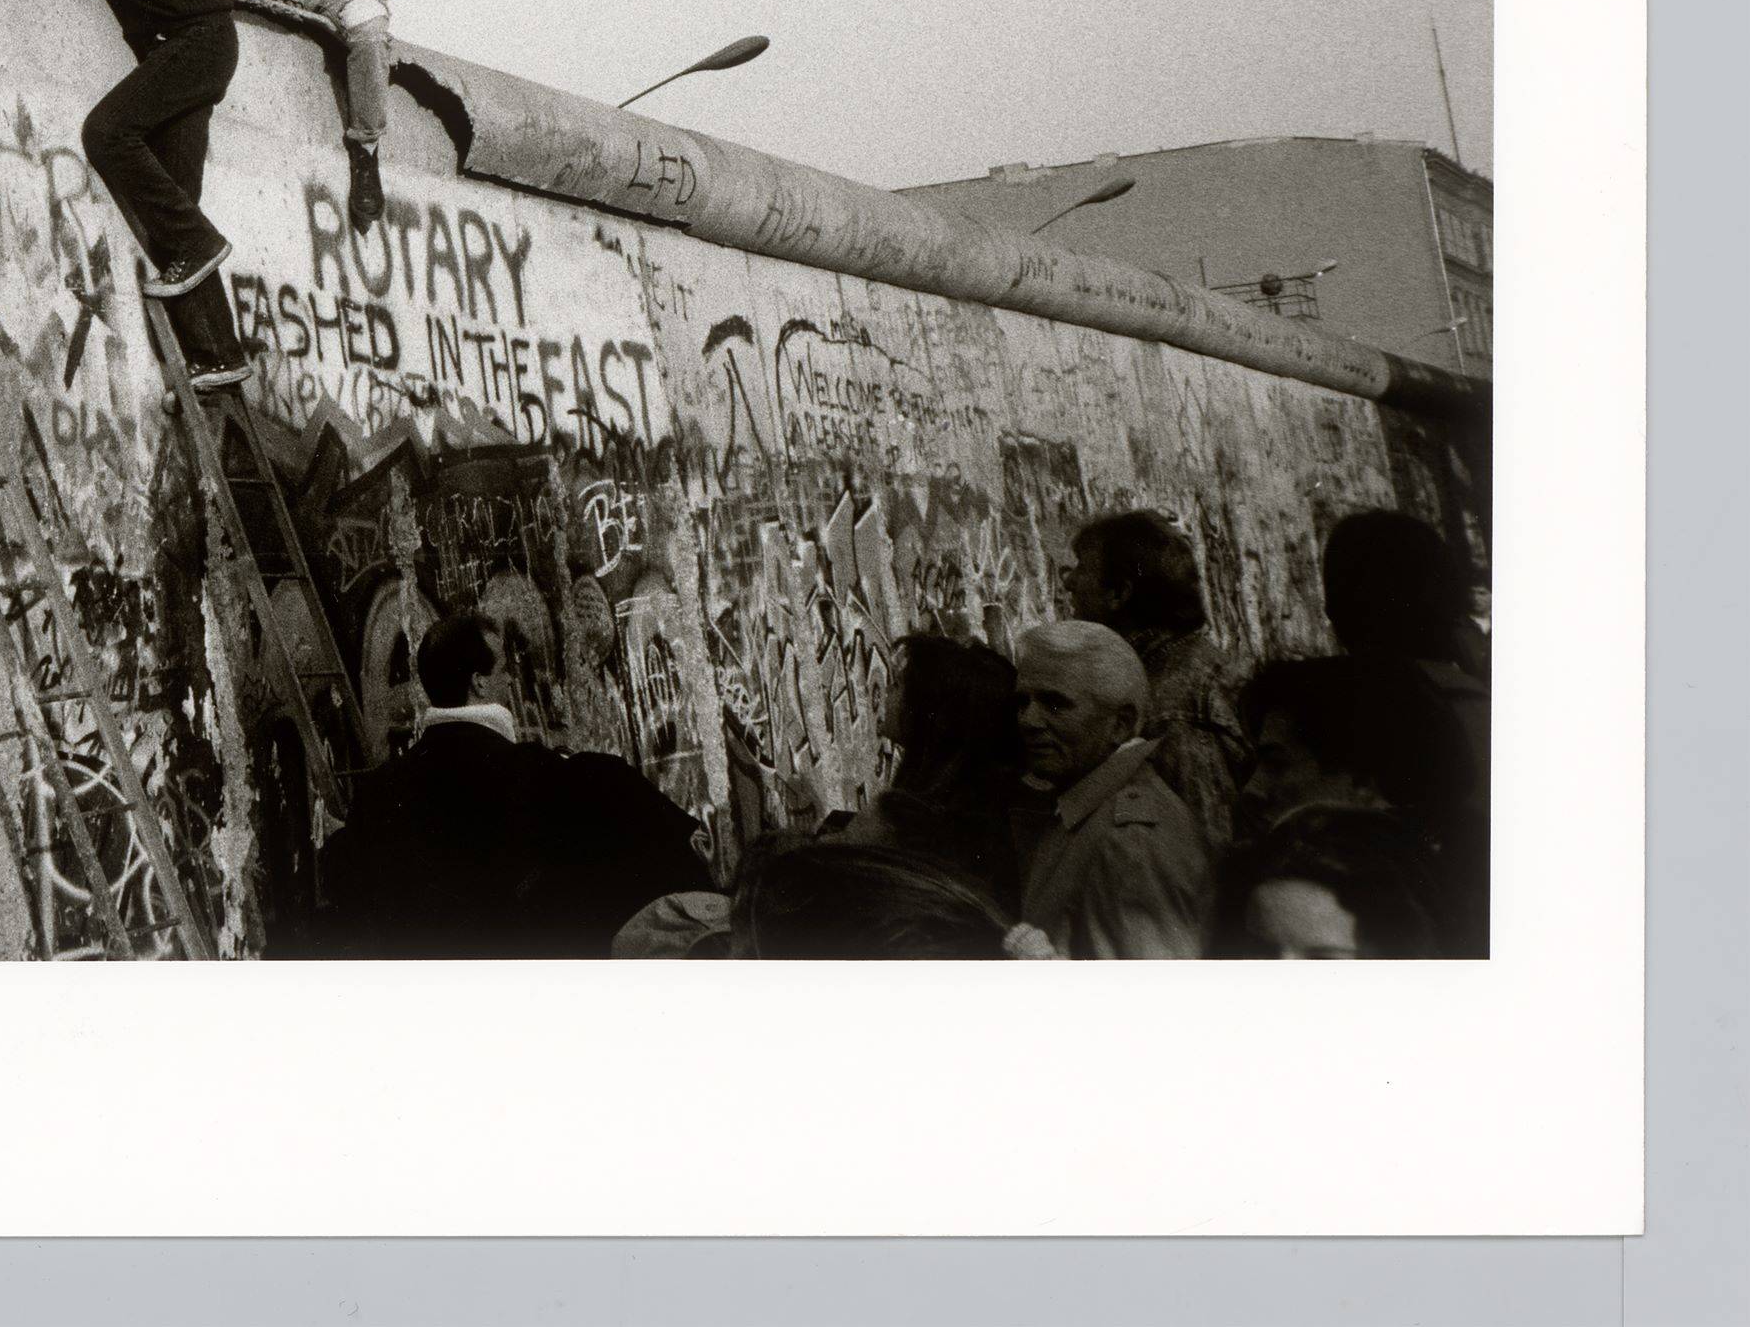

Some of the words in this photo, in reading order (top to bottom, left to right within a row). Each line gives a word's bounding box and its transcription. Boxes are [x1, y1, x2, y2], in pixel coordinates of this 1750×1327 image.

[300, 181, 533, 330] ROTARY
[425, 313, 465, 388] IN
[536, 333, 653, 452] EAST
